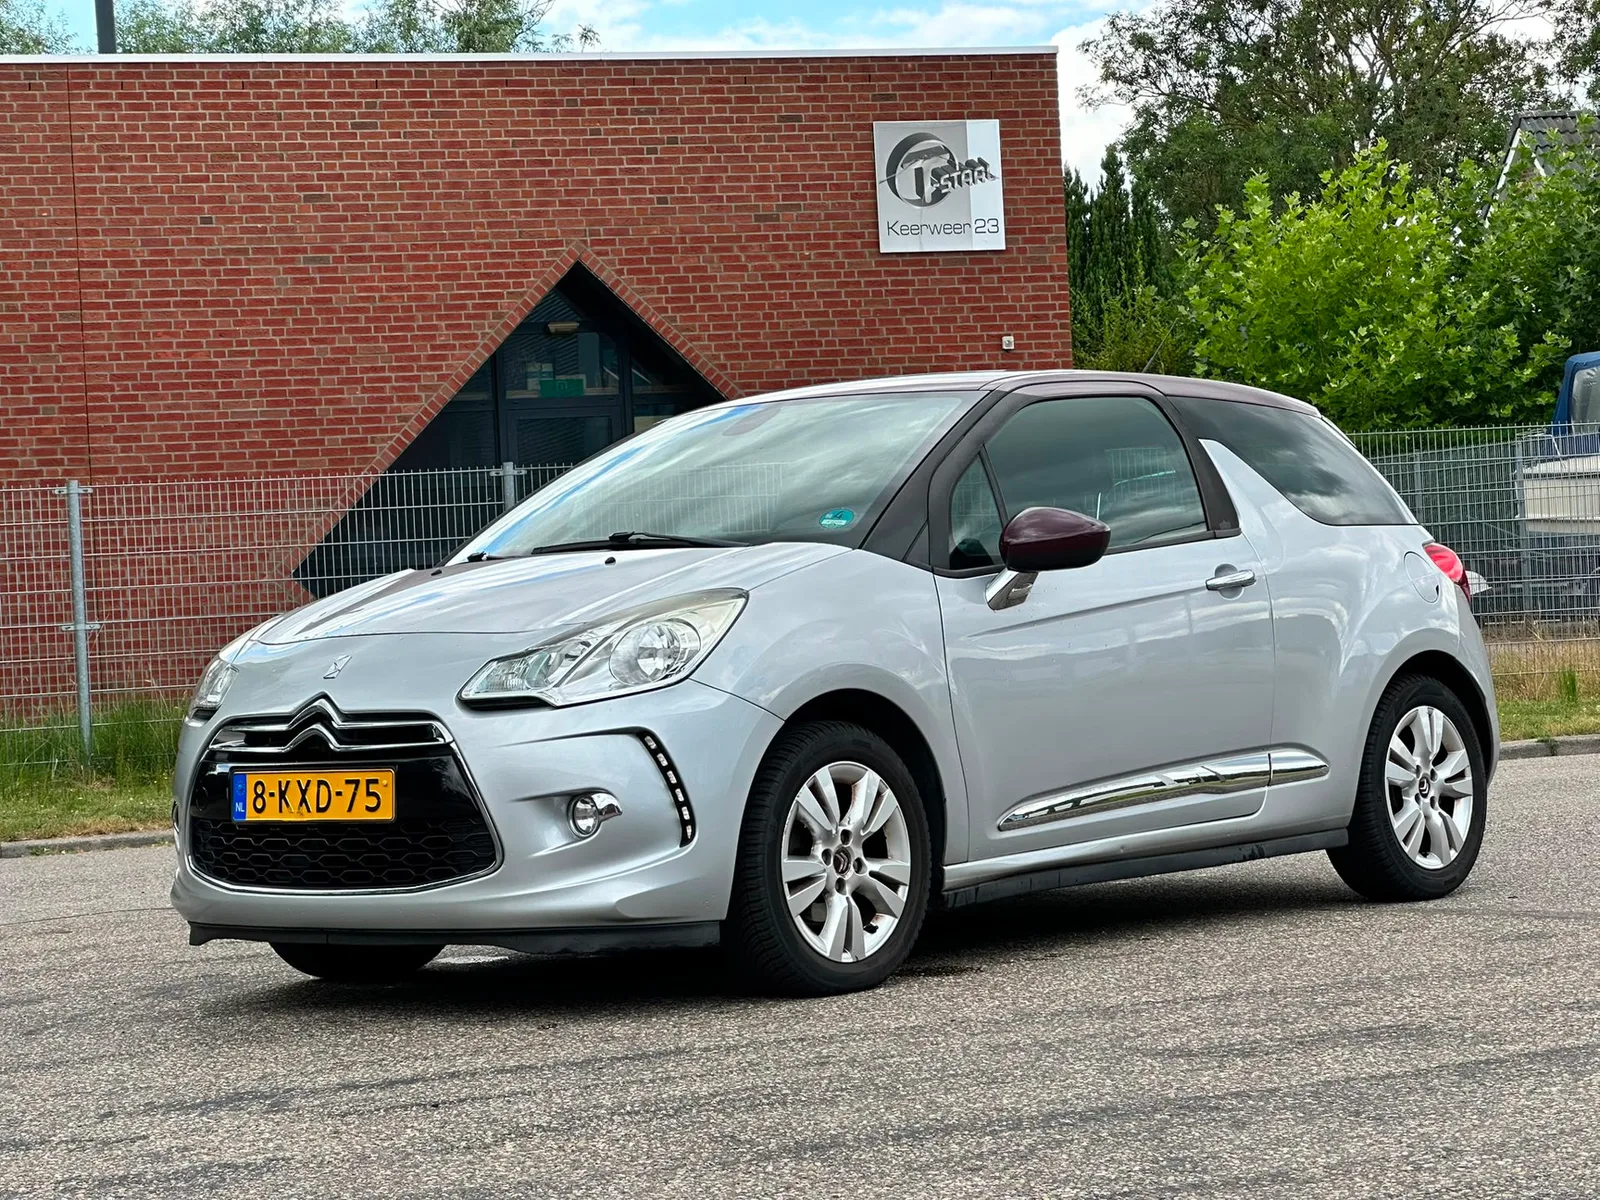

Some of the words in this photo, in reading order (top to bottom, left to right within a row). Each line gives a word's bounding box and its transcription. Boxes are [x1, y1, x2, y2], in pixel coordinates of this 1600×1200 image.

[886, 220, 972, 236] Keerweer
[974, 217, 1000, 235] 23
[252, 778, 382, 814] 8-KXD-75
[235, 802, 245, 813] NL
